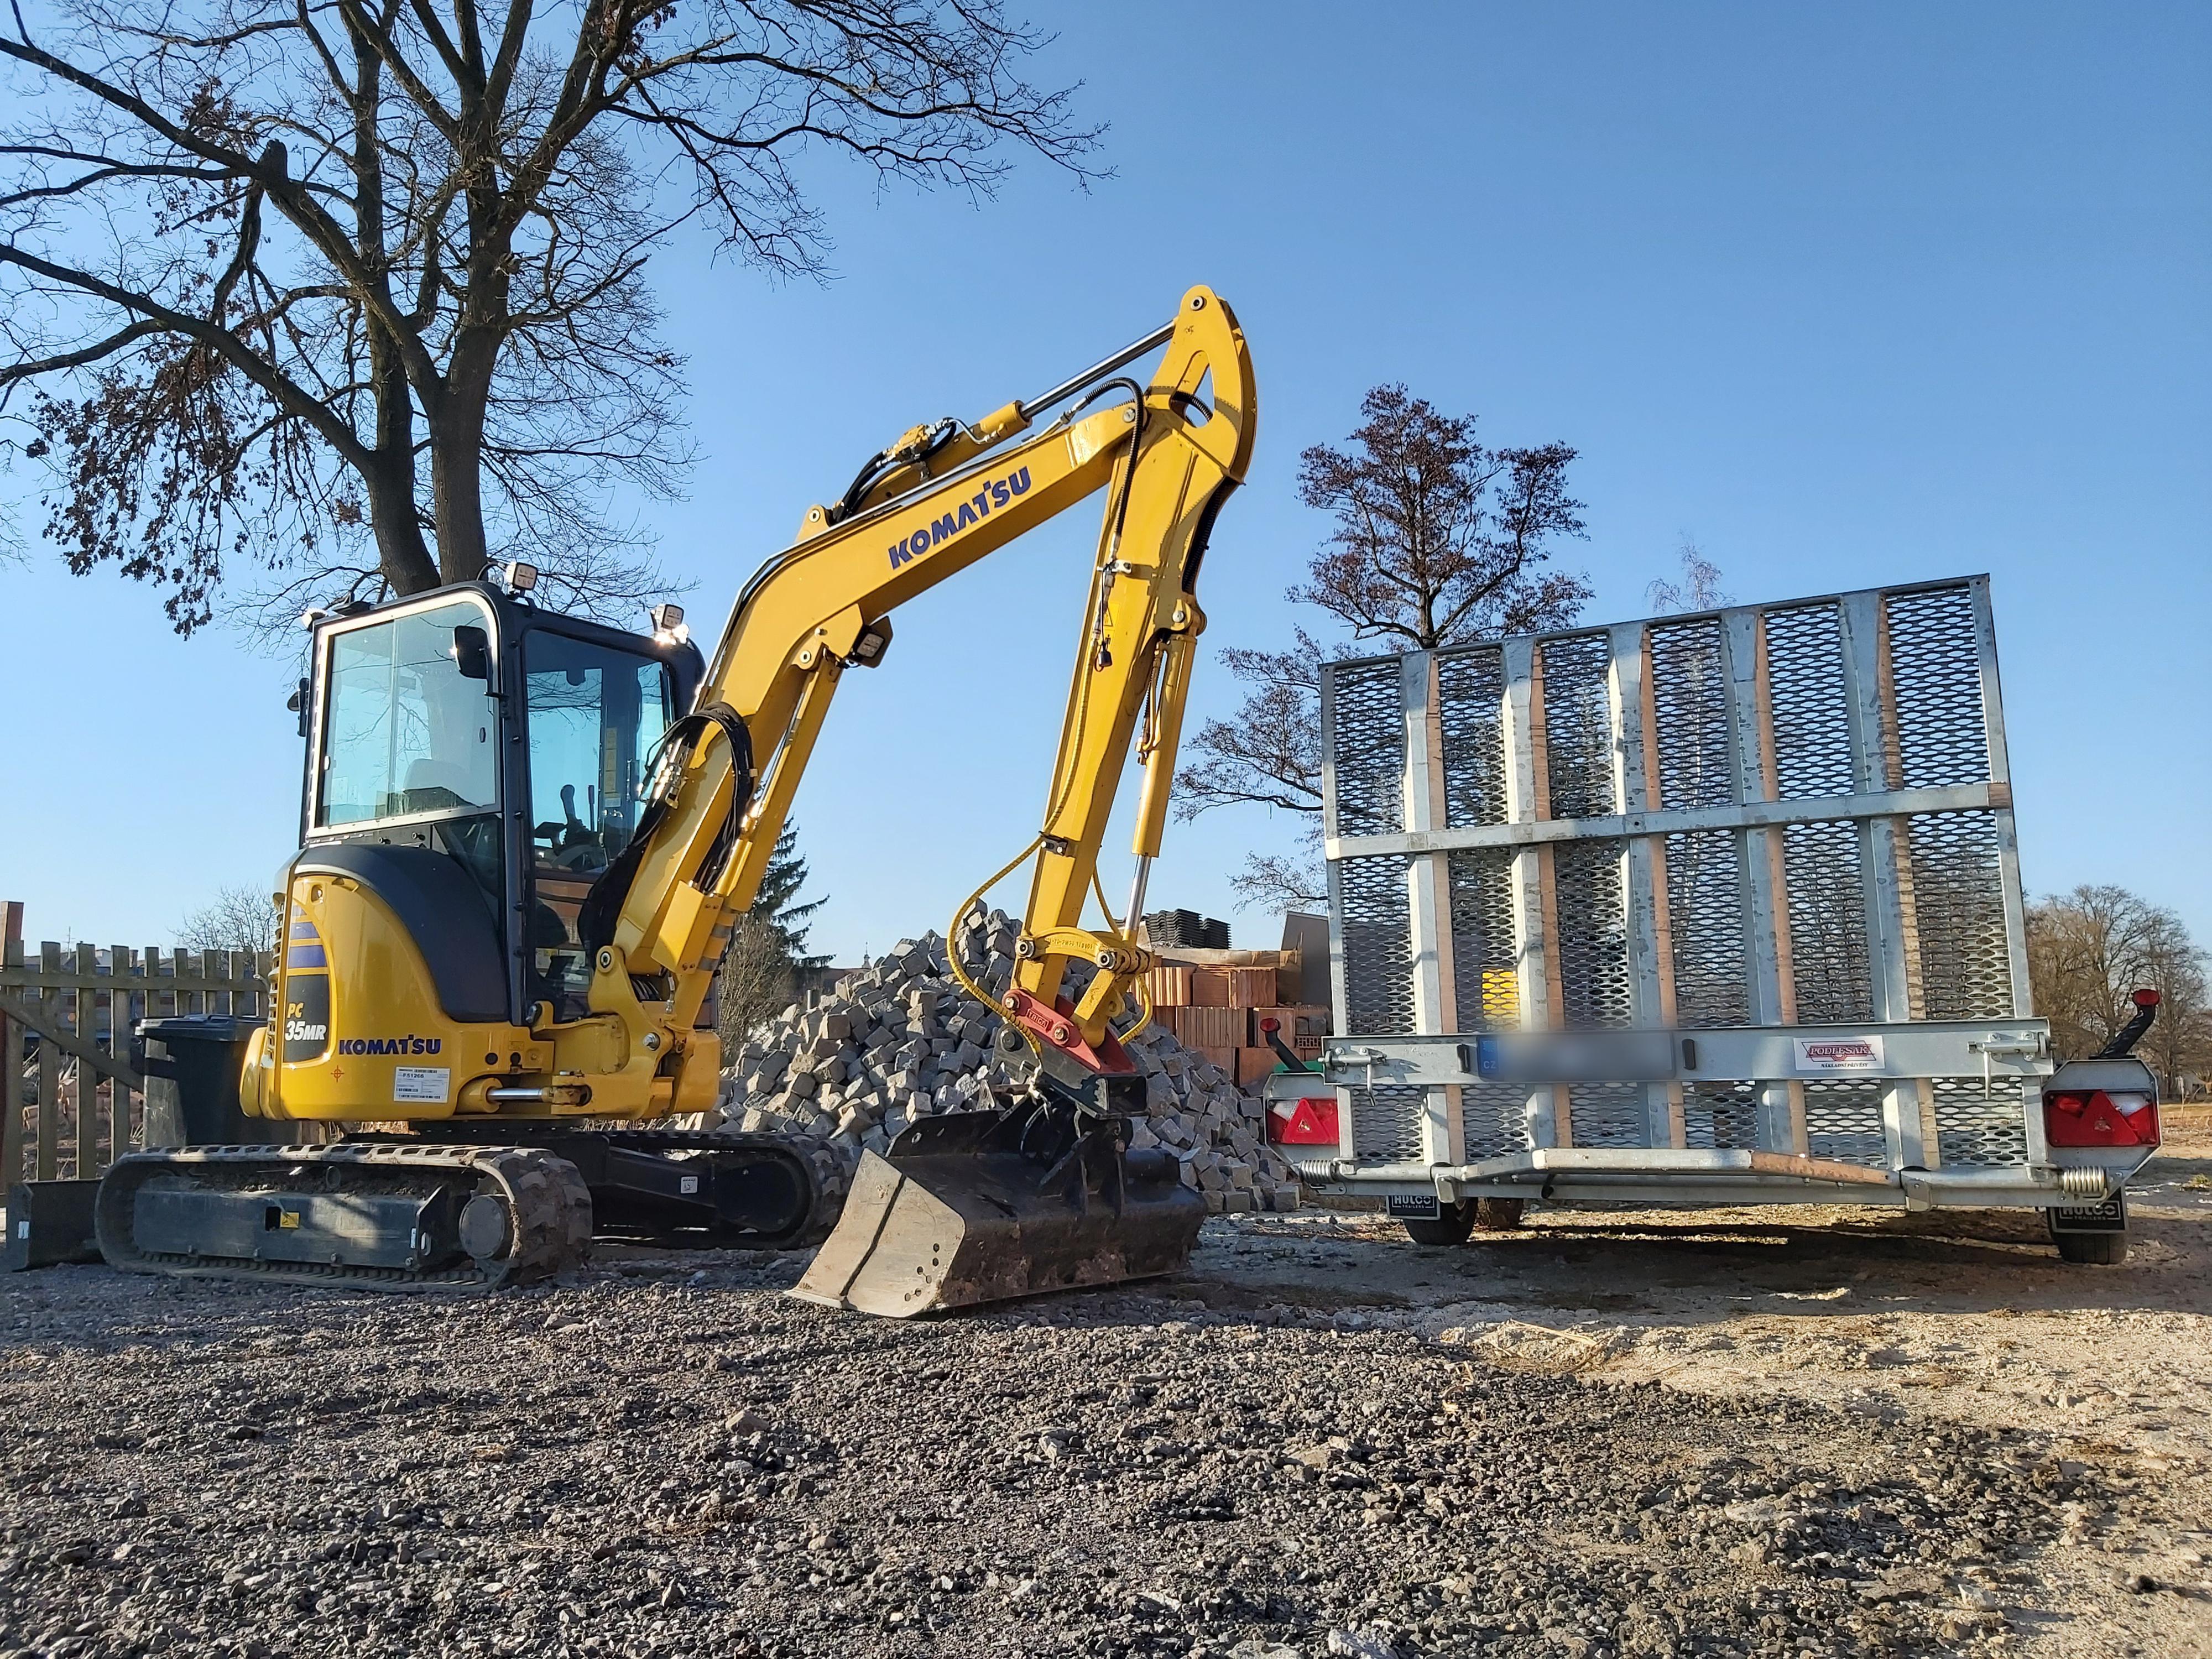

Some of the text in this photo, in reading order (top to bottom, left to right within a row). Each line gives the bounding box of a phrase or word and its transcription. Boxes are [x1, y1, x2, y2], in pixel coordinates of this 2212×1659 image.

[888, 466, 1031, 570] KOMATSU
[287, 1003, 304, 1018] PC
[285, 1021, 326, 1041] 35MR
[339, 1034, 441, 1055] KOMATSU
[1483, 1061, 1496, 1069] CZ
[1394, 1196, 1431, 1204] HULCO
